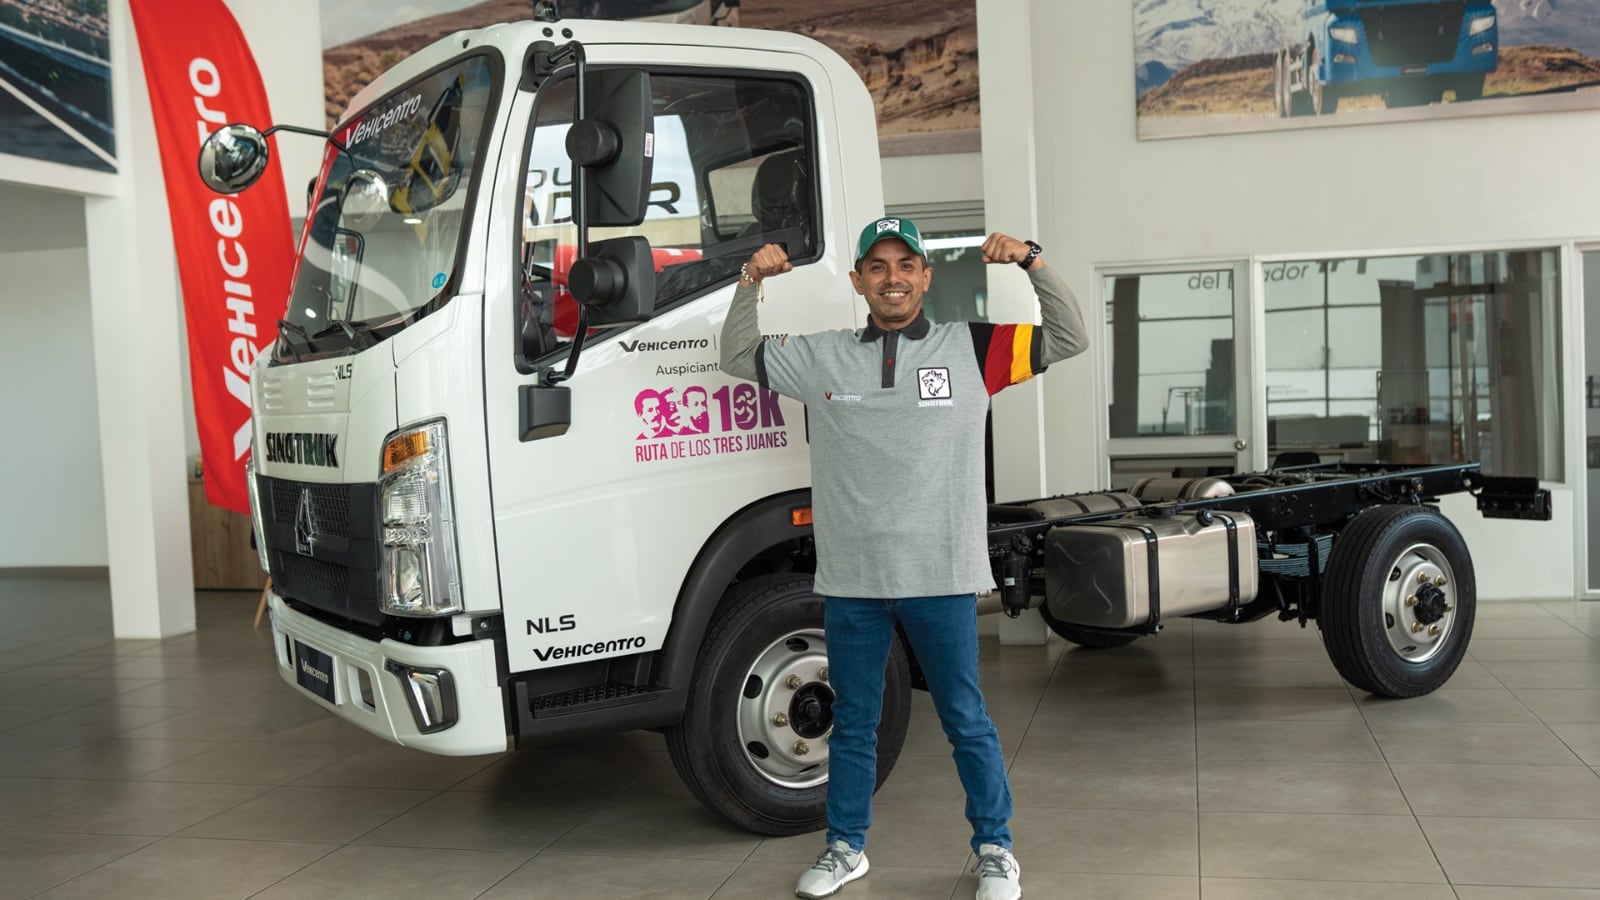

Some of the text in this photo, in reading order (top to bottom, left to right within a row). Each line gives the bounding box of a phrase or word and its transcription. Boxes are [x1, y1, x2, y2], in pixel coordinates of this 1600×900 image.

[656, 361, 721, 377] Auspiciant
[266, 432, 339, 468] SINOTRUK
[635, 431, 788, 463] RUTA DE LOS TRES JUANES
[526, 614, 576, 635] NLS
